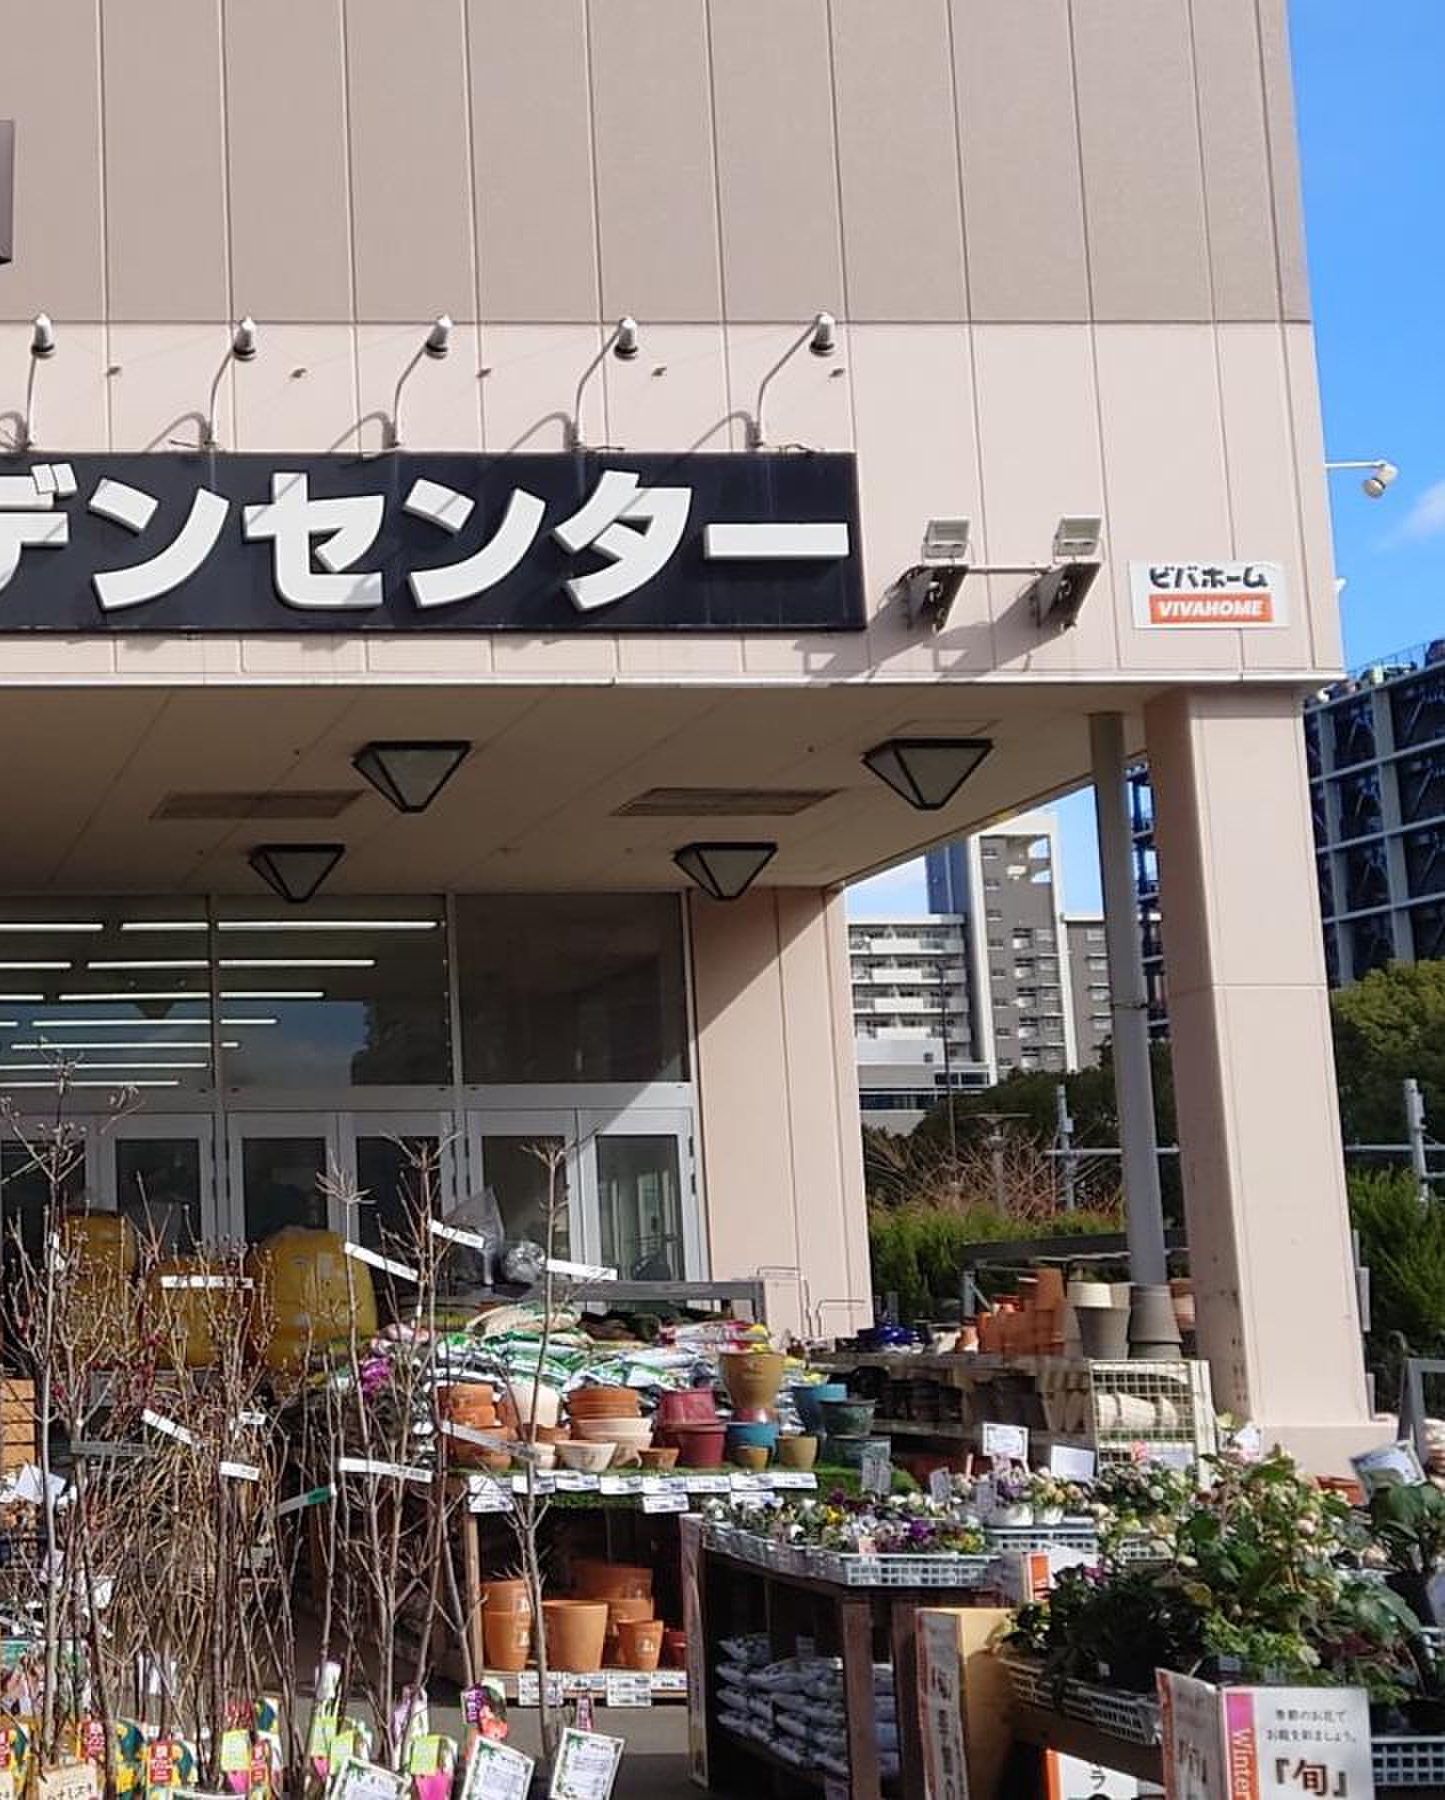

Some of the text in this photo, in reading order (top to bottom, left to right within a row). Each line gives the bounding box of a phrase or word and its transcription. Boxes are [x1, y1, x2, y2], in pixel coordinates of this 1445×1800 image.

[1149, 566, 1268, 589] ビバホーム
[1158, 600, 1263, 617] VIVAHOME
